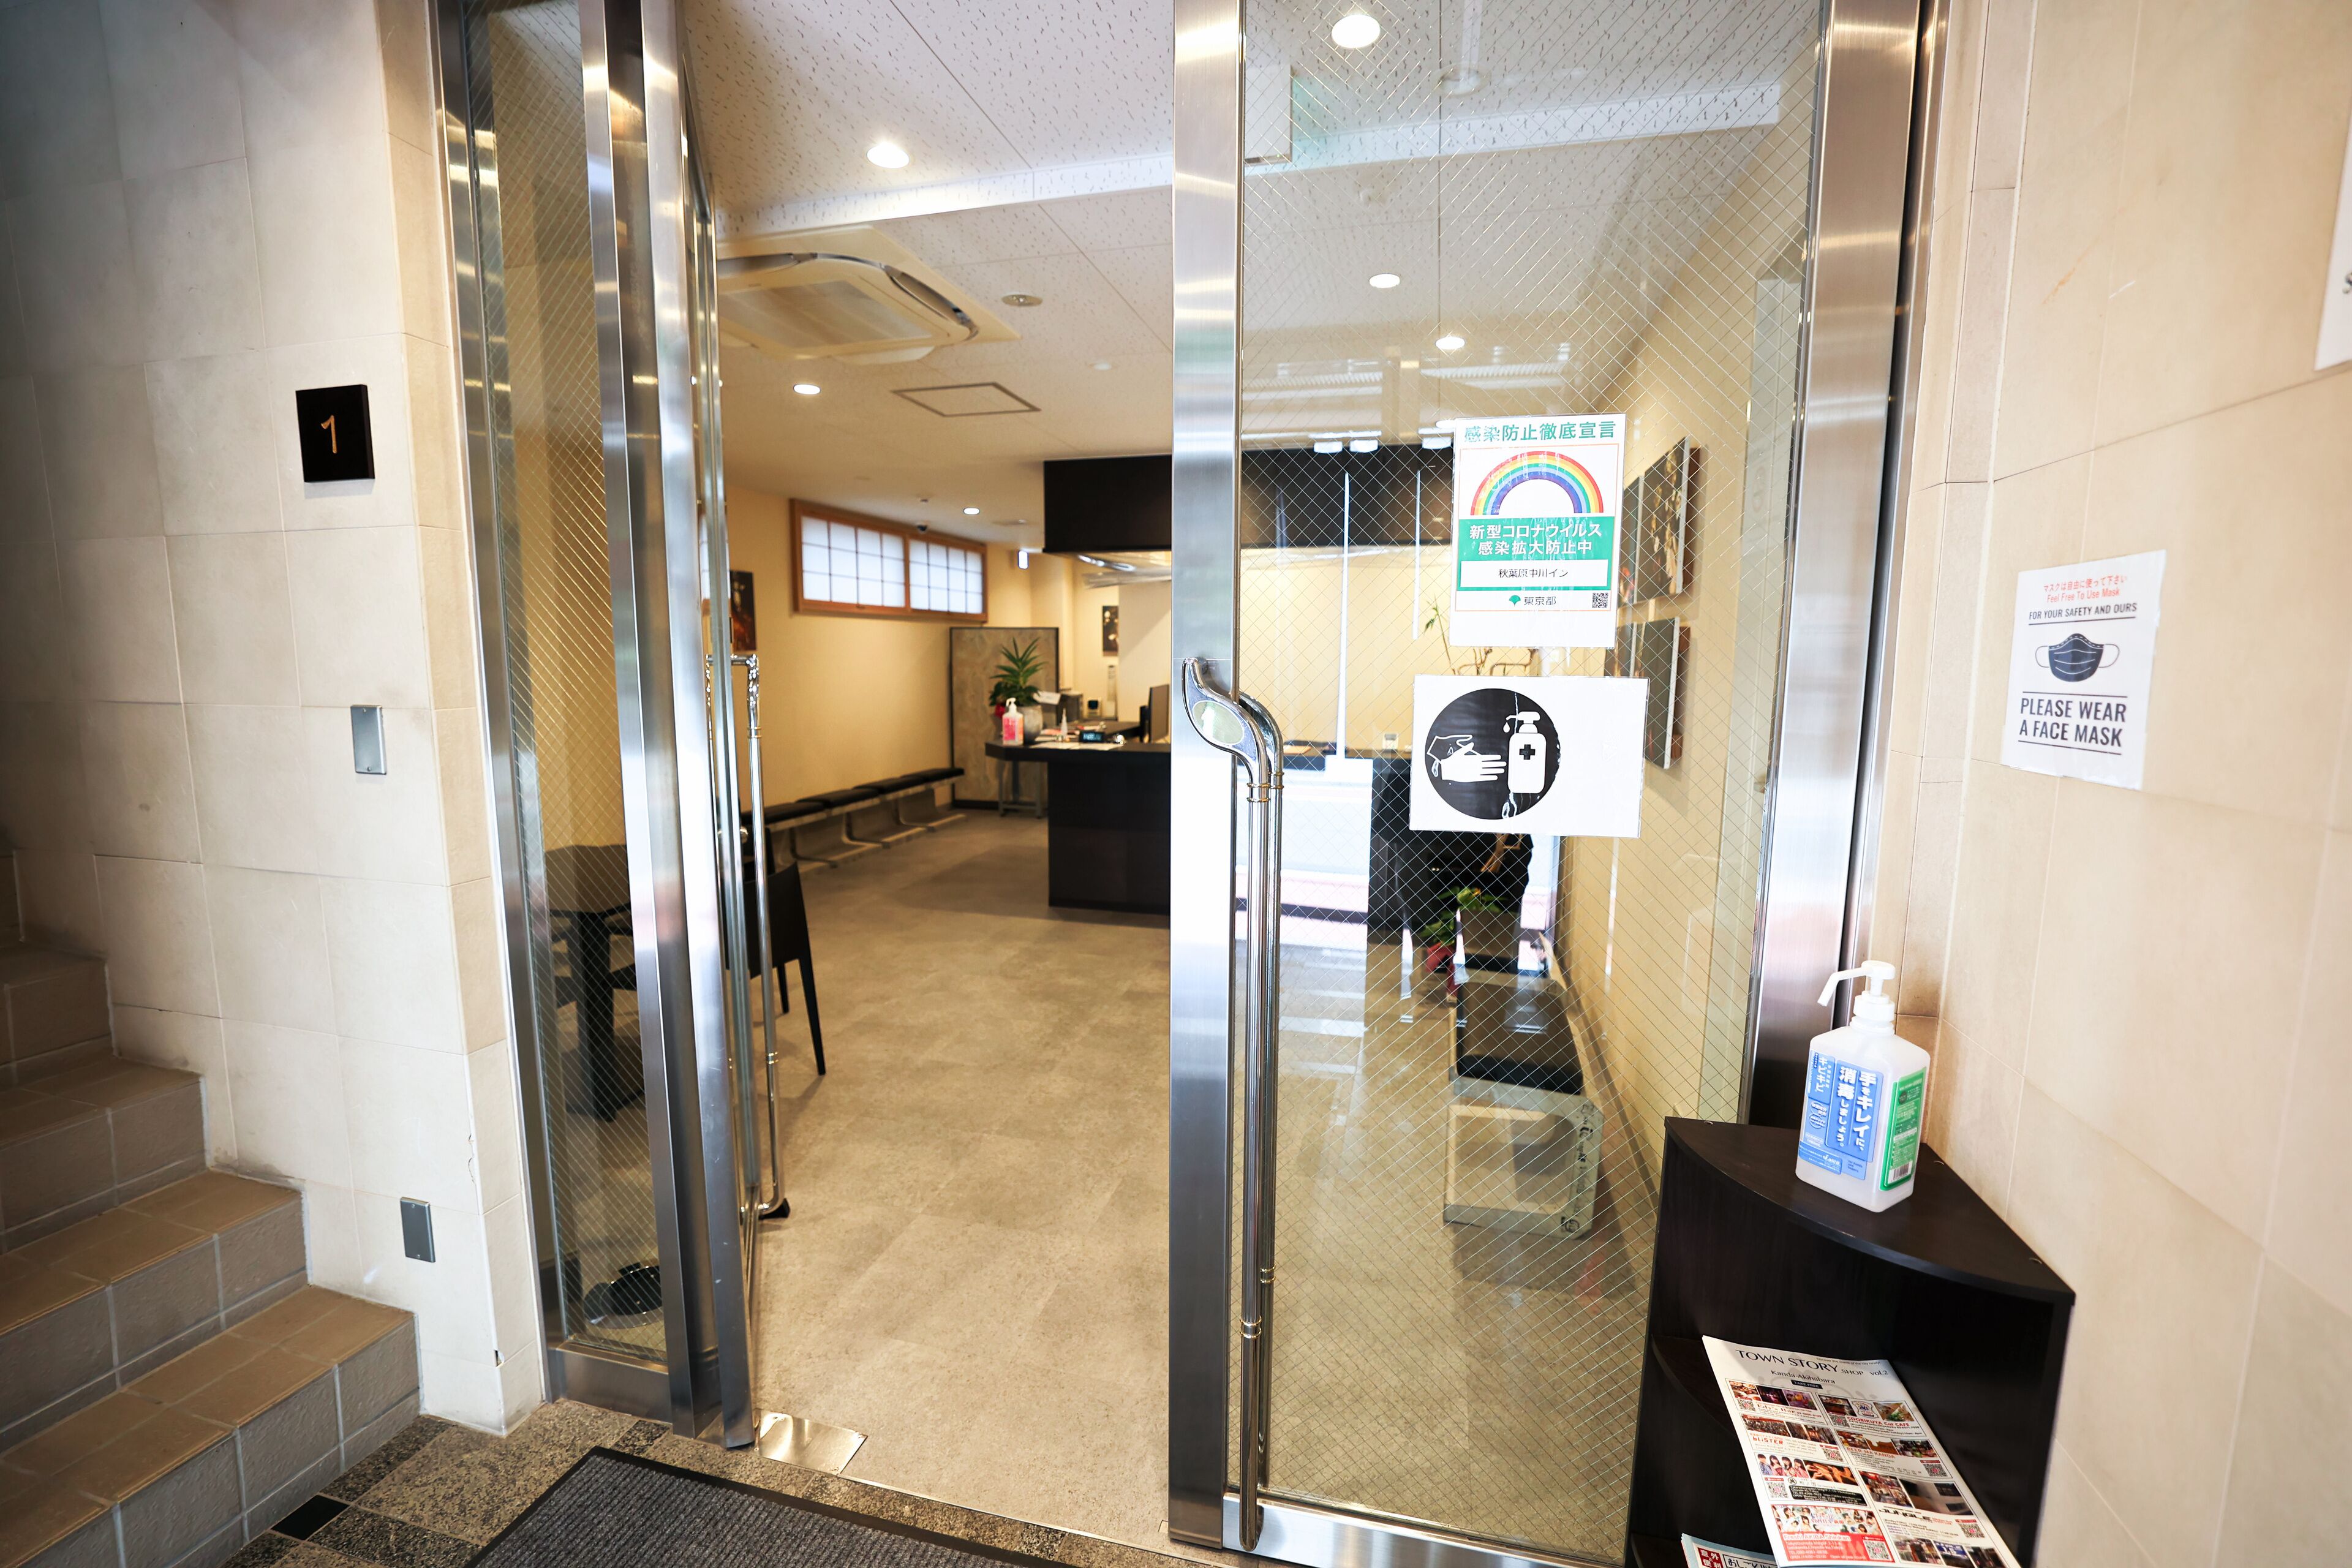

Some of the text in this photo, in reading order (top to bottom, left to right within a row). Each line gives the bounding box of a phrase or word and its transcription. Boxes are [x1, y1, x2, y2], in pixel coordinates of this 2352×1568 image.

[320, 415, 337, 454] 1
[1464, 421, 1616, 443] 感染防止徹底宣言
[1469, 522, 1603, 540] 新型コロナウイルス
[1477, 540, 1593, 556] 感染拡大防止中
[1498, 568, 1569, 578] 秋葉原中川イン
[2043, 575, 2128, 592] マスクは自由に使って下さい
[1524, 596, 1556, 606] 東京都
[2047, 587, 2120, 603] Feel Free To Use Mask
[2029, 602, 2138, 620] FOR YOUR SAFETY AND OURS
[2020, 697, 2127, 723] PLEASE WEAR
[2019, 719, 2122, 747] A FACE MASK
[1735, 1349, 1784, 1365] TOWN
[1788, 1357, 1838, 1373] STORY
[1771, 1370, 1836, 1384] Kanda-Akihabara
